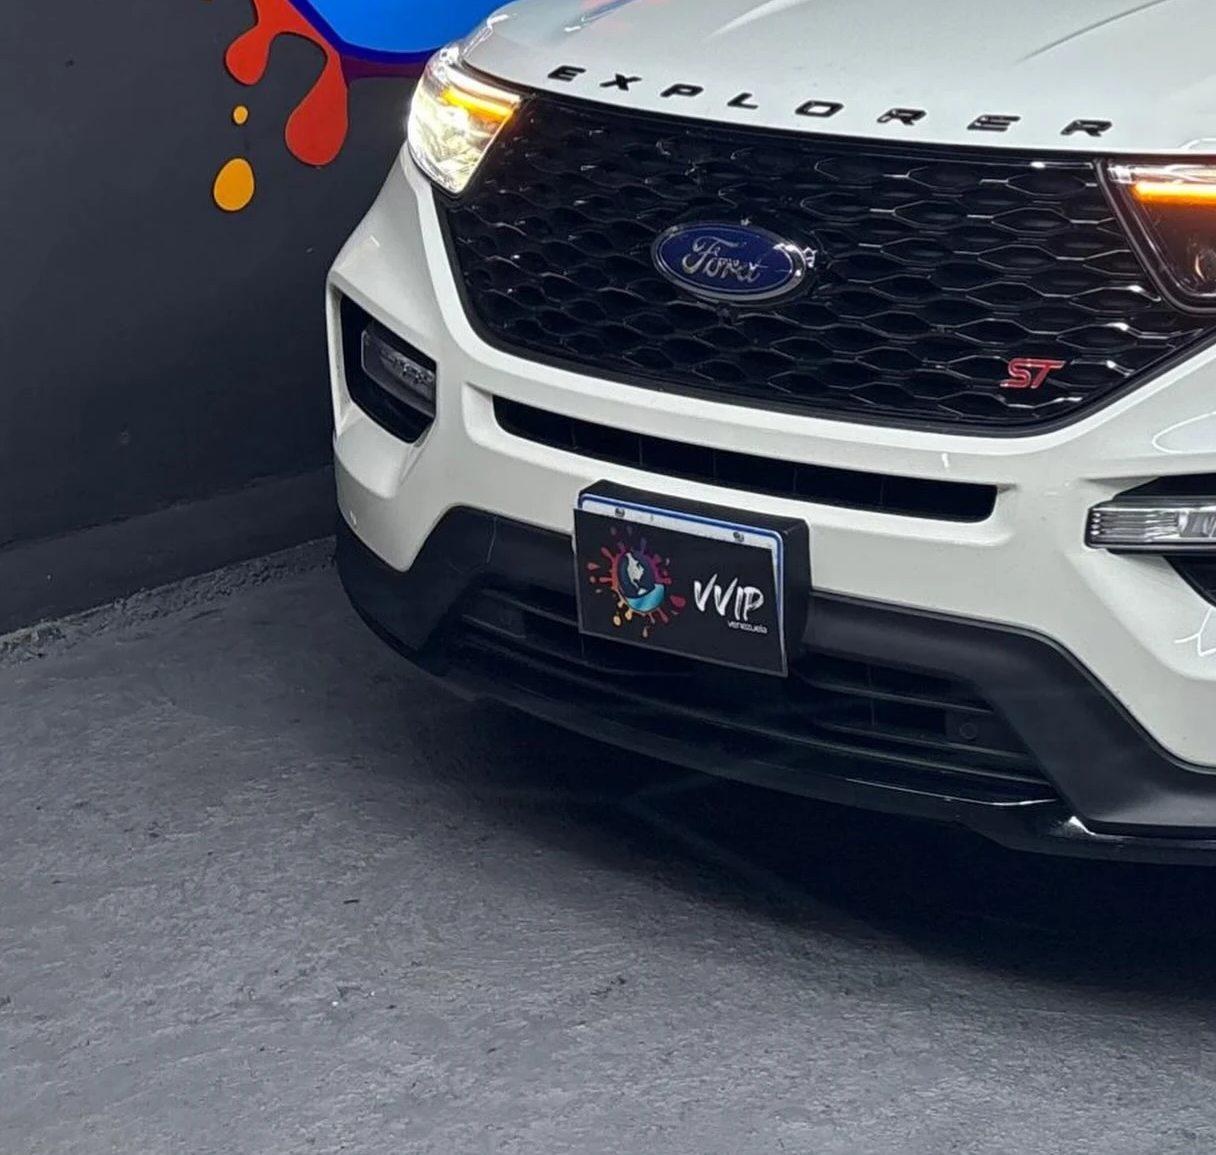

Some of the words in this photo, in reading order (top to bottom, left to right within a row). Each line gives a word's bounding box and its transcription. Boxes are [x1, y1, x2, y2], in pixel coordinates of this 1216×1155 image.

[547, 64, 1113, 137] EXPLORER
[682, 236, 768, 283] Ford
[1000, 358, 1066, 389] ST
[693, 573, 764, 621] VVIP
